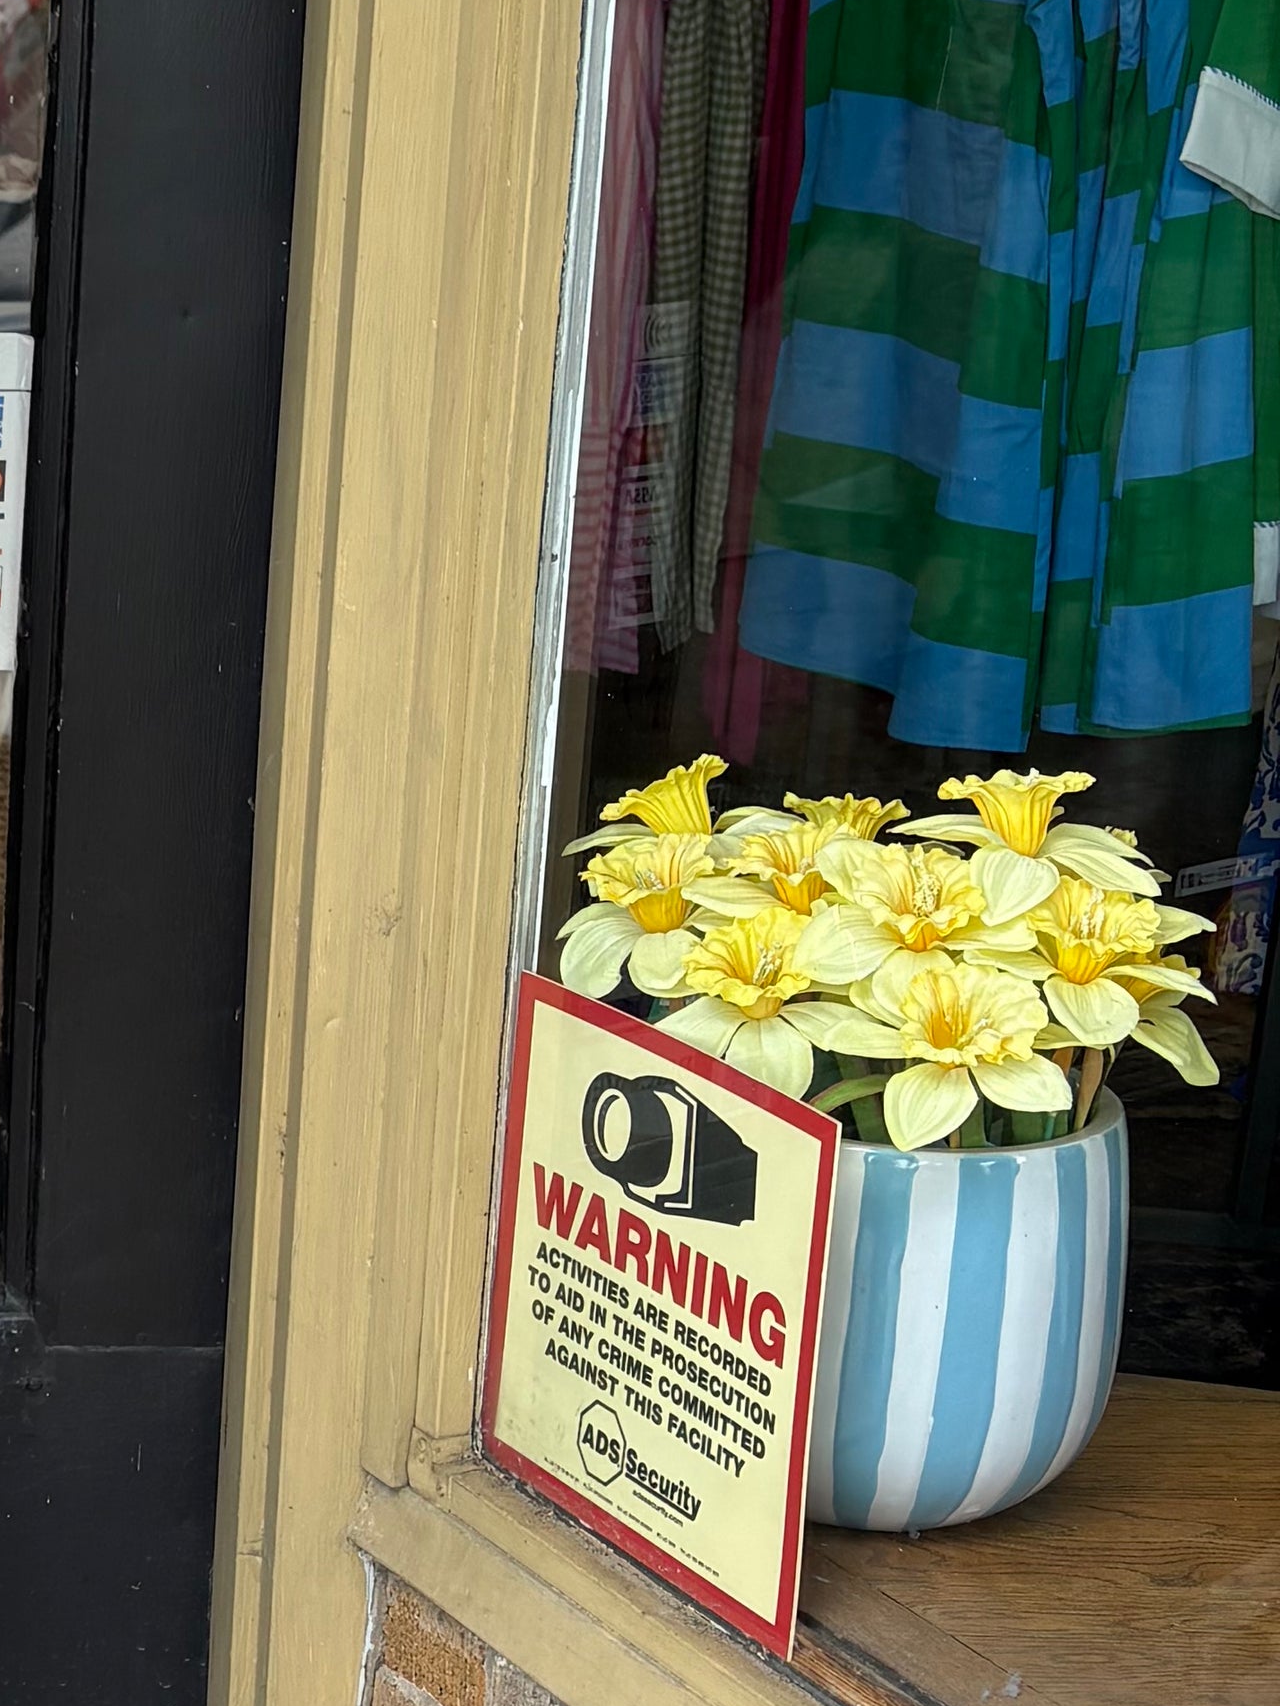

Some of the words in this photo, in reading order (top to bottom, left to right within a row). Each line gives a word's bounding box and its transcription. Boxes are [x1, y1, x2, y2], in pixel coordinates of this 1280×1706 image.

[533, 1162, 788, 1370] WARNING
[536, 1241, 629, 1309] ACTIVITIES
[633, 1296, 669, 1334] ARE
[674, 1319, 772, 1397] RECORDED
[528, 1264, 551, 1294] TO
[555, 1282, 584, 1313] AID
[590, 1300, 607, 1328] IN
[612, 1313, 646, 1352] THE
[650, 1337, 776, 1435] PROSECUTION
[532, 1299, 555, 1326] OF
[558, 1315, 594, 1350] ANY
[598, 1338, 653, 1388] CRIME
[658, 1375, 766, 1460] COMMITTED
[544, 1338, 619, 1397] AGAINST
[624, 1384, 663, 1426] THIS
[667, 1412, 746, 1479] FACILITY
[581, 1422, 621, 1466] ADS
[625, 1447, 702, 1516] Security
